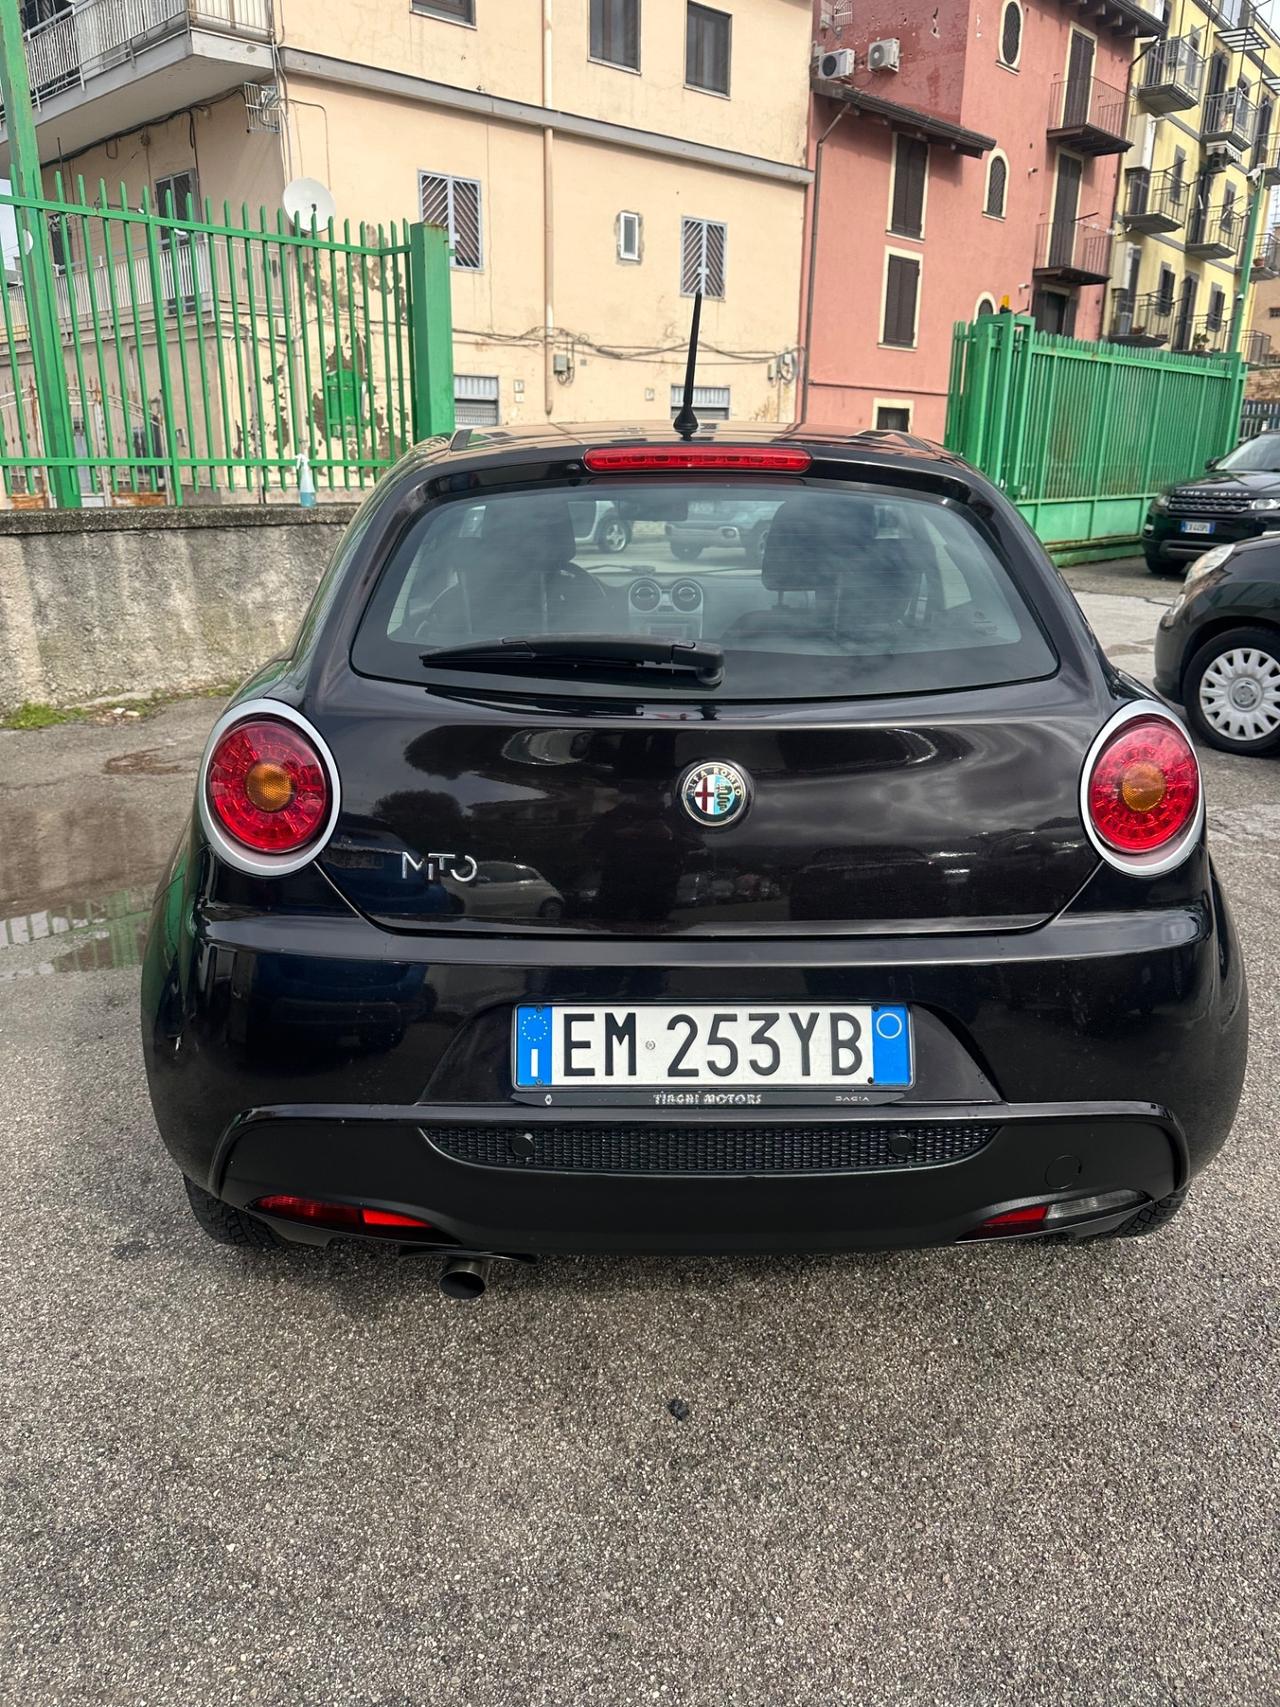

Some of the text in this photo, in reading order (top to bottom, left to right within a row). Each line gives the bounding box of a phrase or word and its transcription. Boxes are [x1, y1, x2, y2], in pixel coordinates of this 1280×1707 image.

[687, 767, 742, 798] ALFA ROMEO
[563, 1012, 863, 1077] EM 253YB
[704, 1093, 762, 1105] MOTORS
